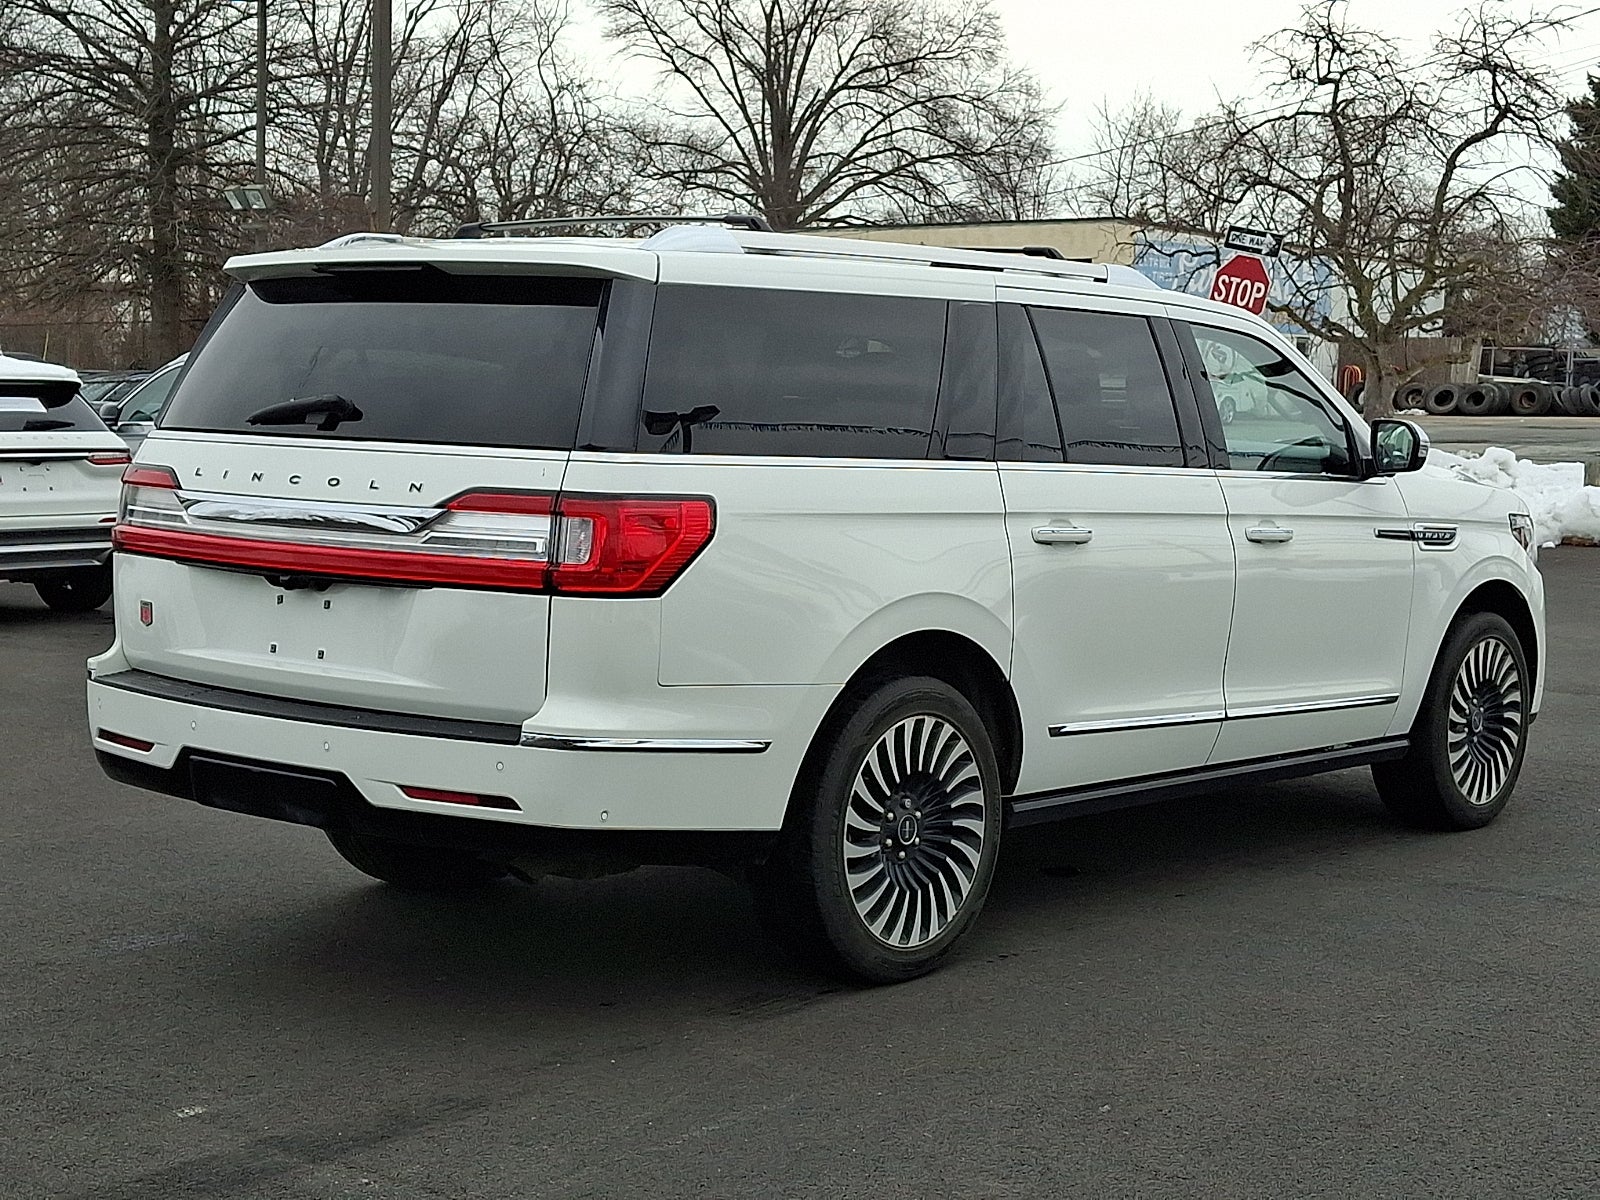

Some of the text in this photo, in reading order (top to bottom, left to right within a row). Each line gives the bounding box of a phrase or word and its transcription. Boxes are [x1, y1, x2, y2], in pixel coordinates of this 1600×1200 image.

[1231, 233, 1266, 247] ONE WAY
[1214, 274, 1266, 309] STOP
[195, 467, 423, 493] LINCOLN
